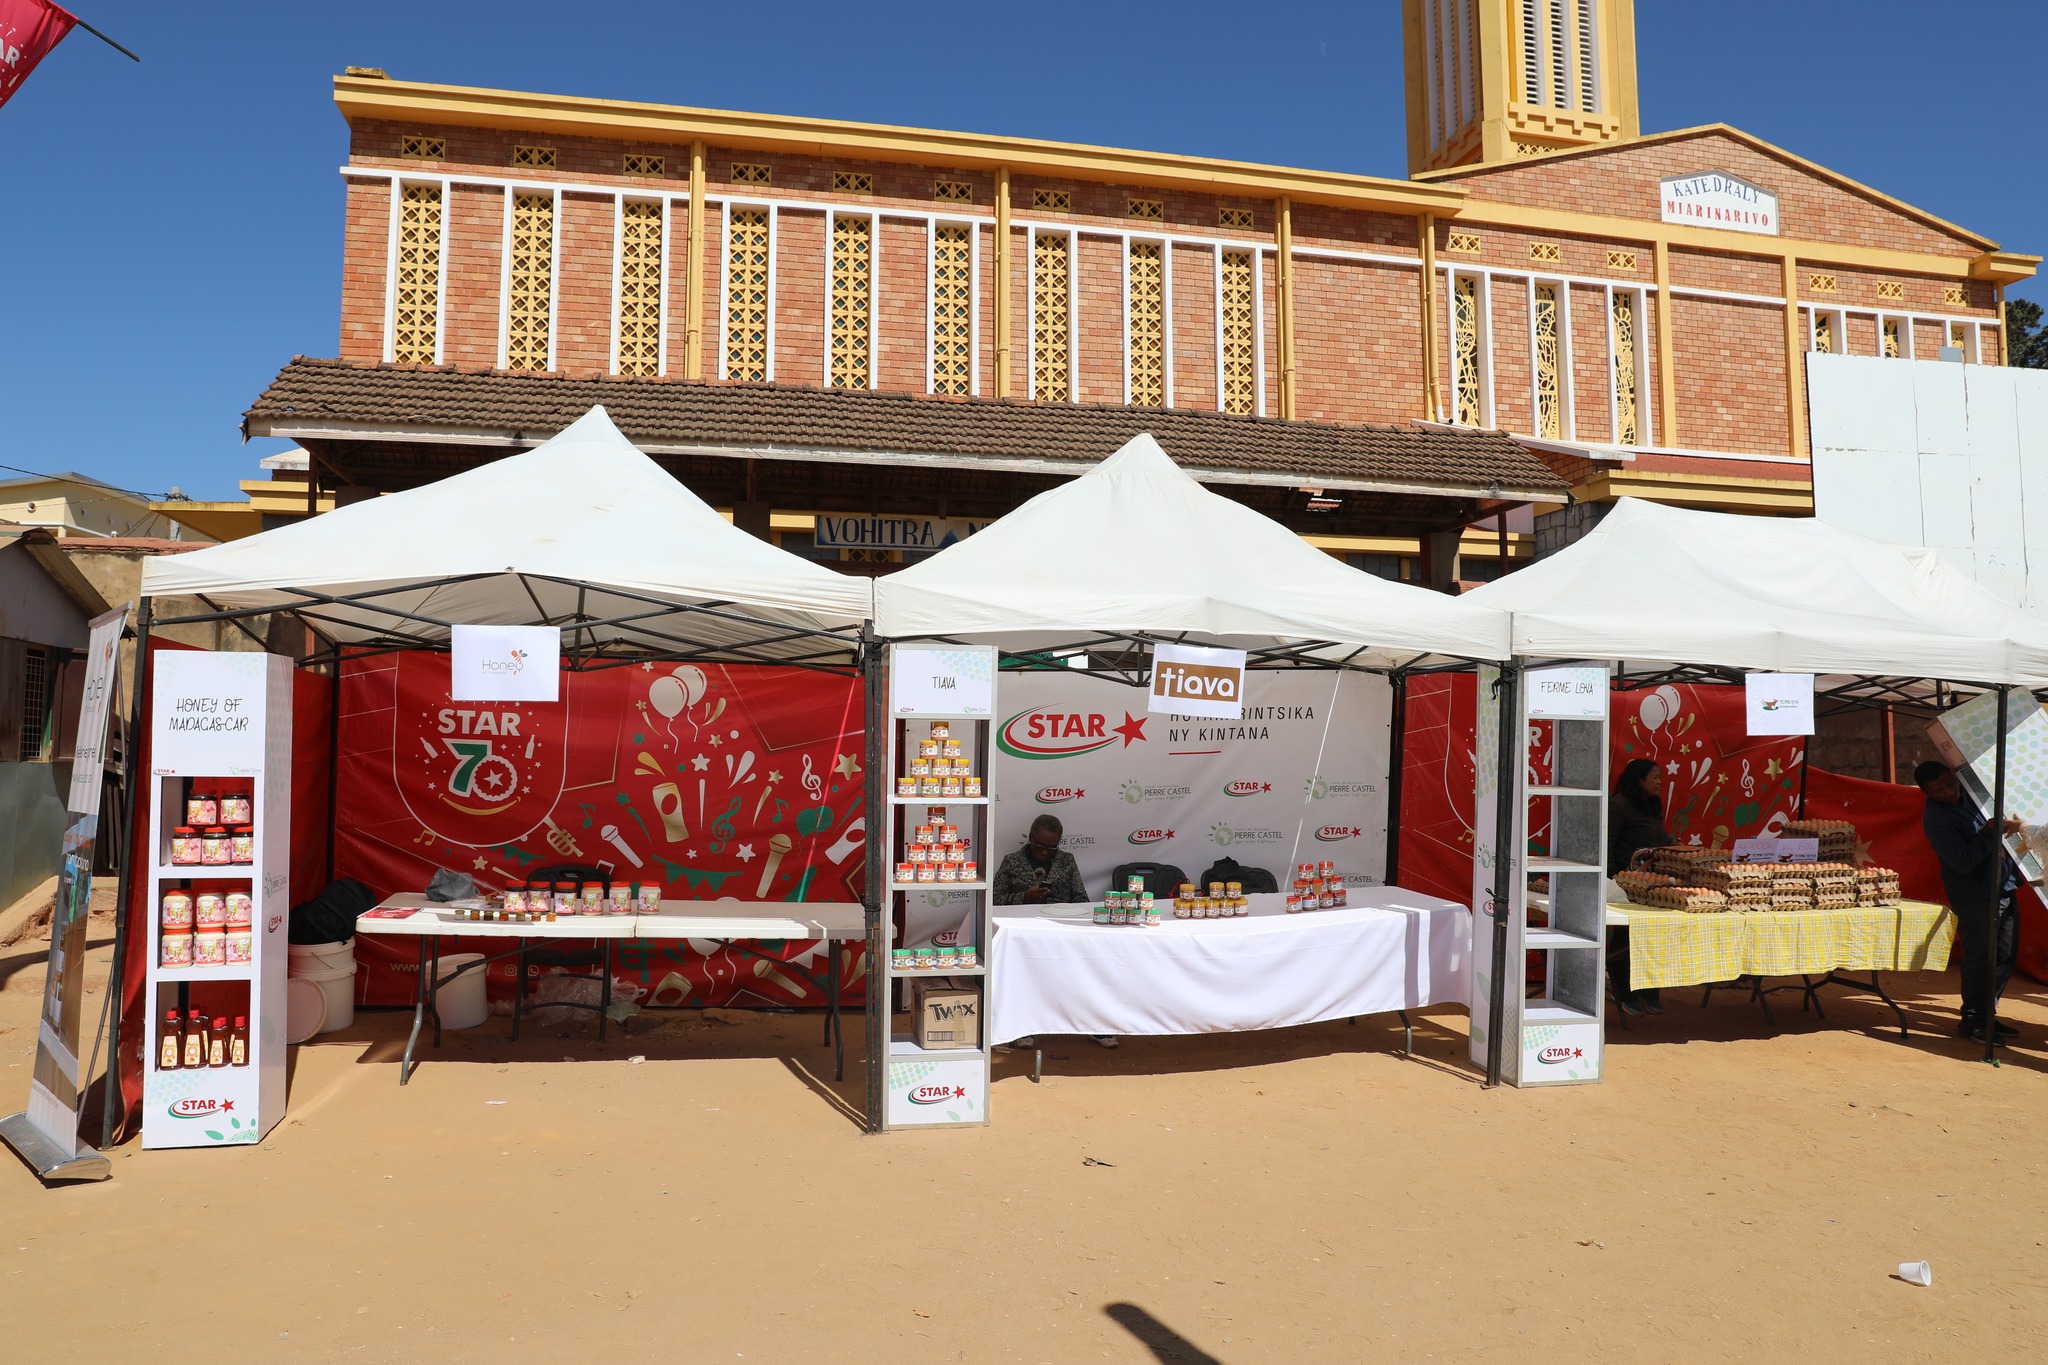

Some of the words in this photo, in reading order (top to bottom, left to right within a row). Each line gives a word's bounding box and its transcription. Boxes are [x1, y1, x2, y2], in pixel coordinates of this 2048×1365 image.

[1667, 201, 1769, 227] MIARINARIVO
[825, 517, 935, 546] VOHITRA
[482, 659, 524, 673] Honey
[932, 676, 956, 690] TIAVA
[1161, 667, 1235, 697] tiava
[1541, 682, 1571, 694] FERME
[1575, 683, 1594, 695] LOVA
[176, 698, 218, 713] HONEY
[224, 698, 243, 713] OF
[168, 717, 249, 731] MADAGASCAR
[437, 708, 521, 737] STAR
[1027, 714, 1106, 739] STAR
[1169, 728, 1190, 742] NY
[1199, 727, 1270, 742] KINTANA
[1144, 788, 1165, 797] PIERRE
[1167, 786, 1192, 795] CASTEL
[1233, 782, 1259, 791] STAR
[1329, 785, 1350, 793] PIERRE
[1351, 784, 1377, 793] CASTEL
[1045, 788, 1072, 798] STAR
[1137, 829, 1163, 838] STAR
[1234, 831, 1256, 839] PIERRE
[1257, 831, 1284, 839] CASTEL
[1324, 826, 1349, 835] STAR
[1069, 837, 1096, 845] CASTEL
[1348, 875, 1374, 883] CASTEL
[948, 891, 970, 899] PIERRE
[1546, 1048, 1571, 1058] STAR
[920, 1086, 950, 1097] STAR
[182, 1099, 217, 1111] STAR
